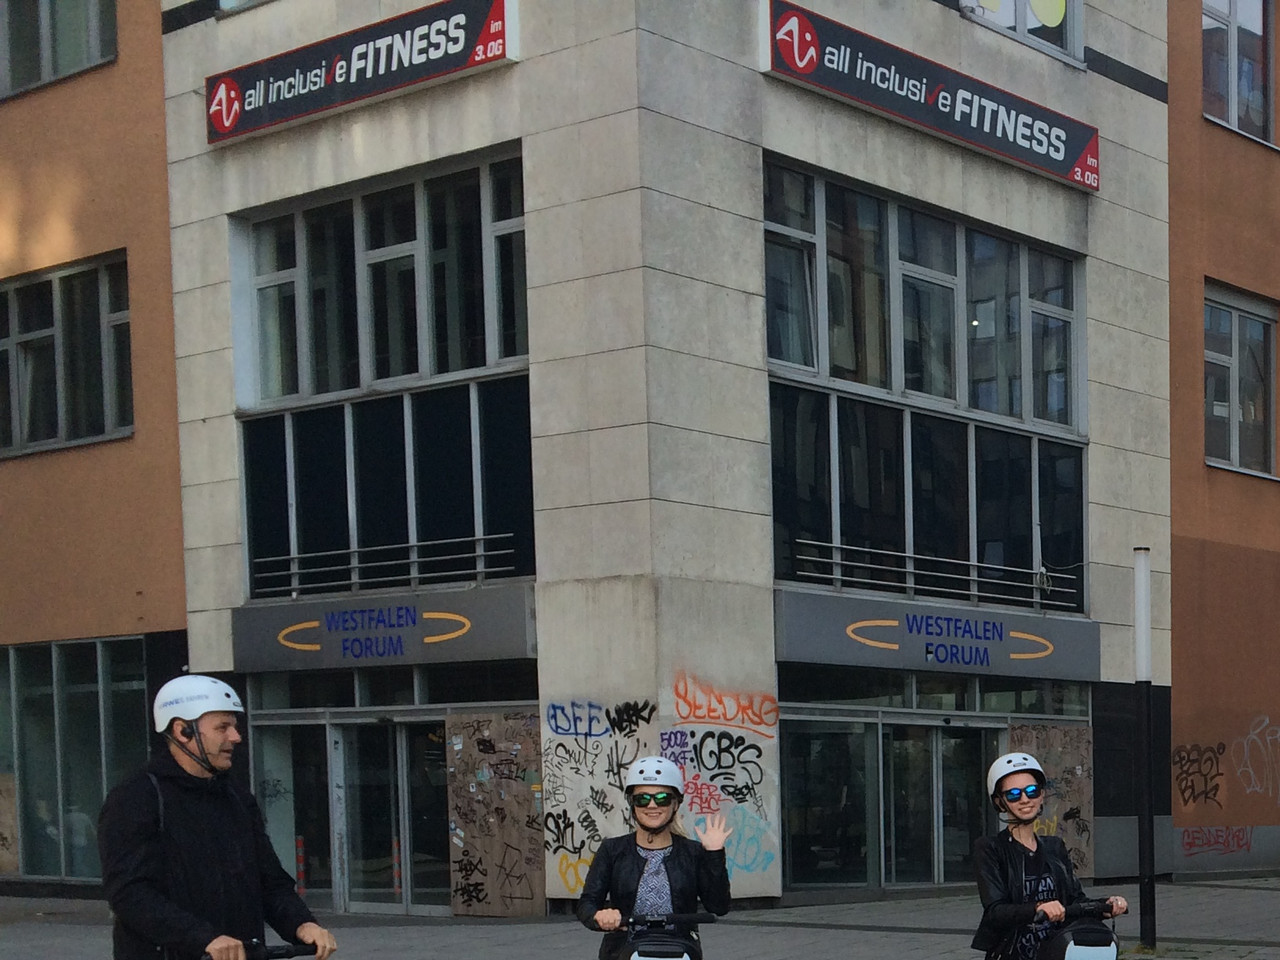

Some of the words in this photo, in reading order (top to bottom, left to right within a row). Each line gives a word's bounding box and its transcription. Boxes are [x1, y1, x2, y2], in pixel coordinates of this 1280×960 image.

[489, 20, 503, 34] im
[244, 80, 264, 111] all
[350, 13, 466, 82] FITNESS
[824, 44, 850, 73] all
[955, 88, 1067, 161] FITNESS
[1087, 154, 1098, 168] im
[324, 606, 417, 632] WESTFALEN
[905, 613, 1003, 641] WESTFALEN
[342, 635, 404, 659] FORUM
[925, 642, 990, 666] FORUM
